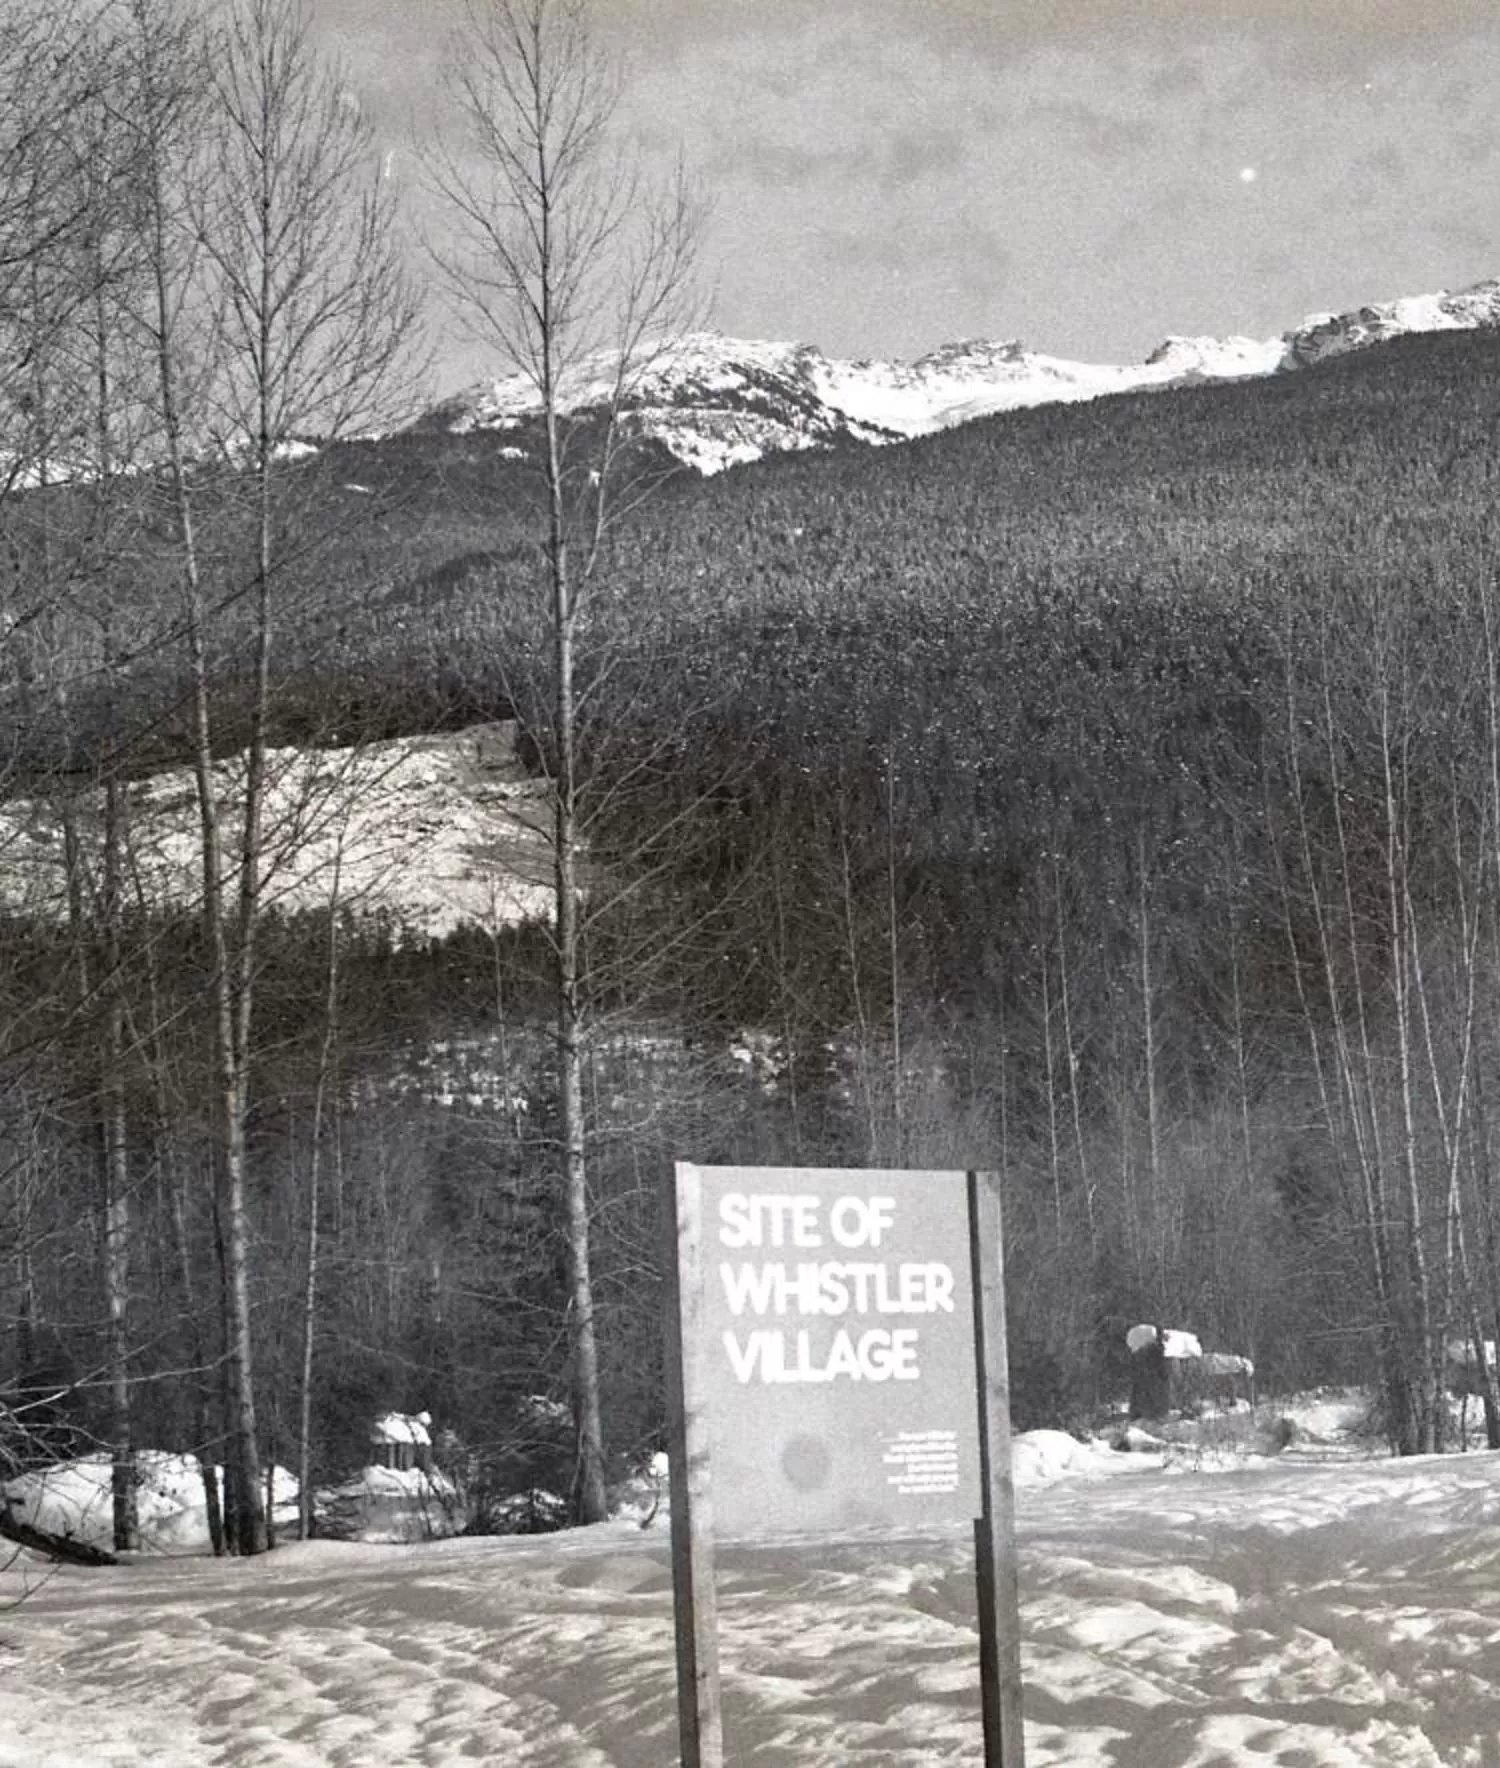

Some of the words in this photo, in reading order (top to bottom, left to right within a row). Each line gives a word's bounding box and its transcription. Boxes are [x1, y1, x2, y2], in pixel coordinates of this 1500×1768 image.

[719, 1193, 821, 1248] SITE
[830, 1196, 896, 1248] OF
[719, 1261, 955, 1315] WHISTLER
[723, 1329, 919, 1384] VILLAGE
